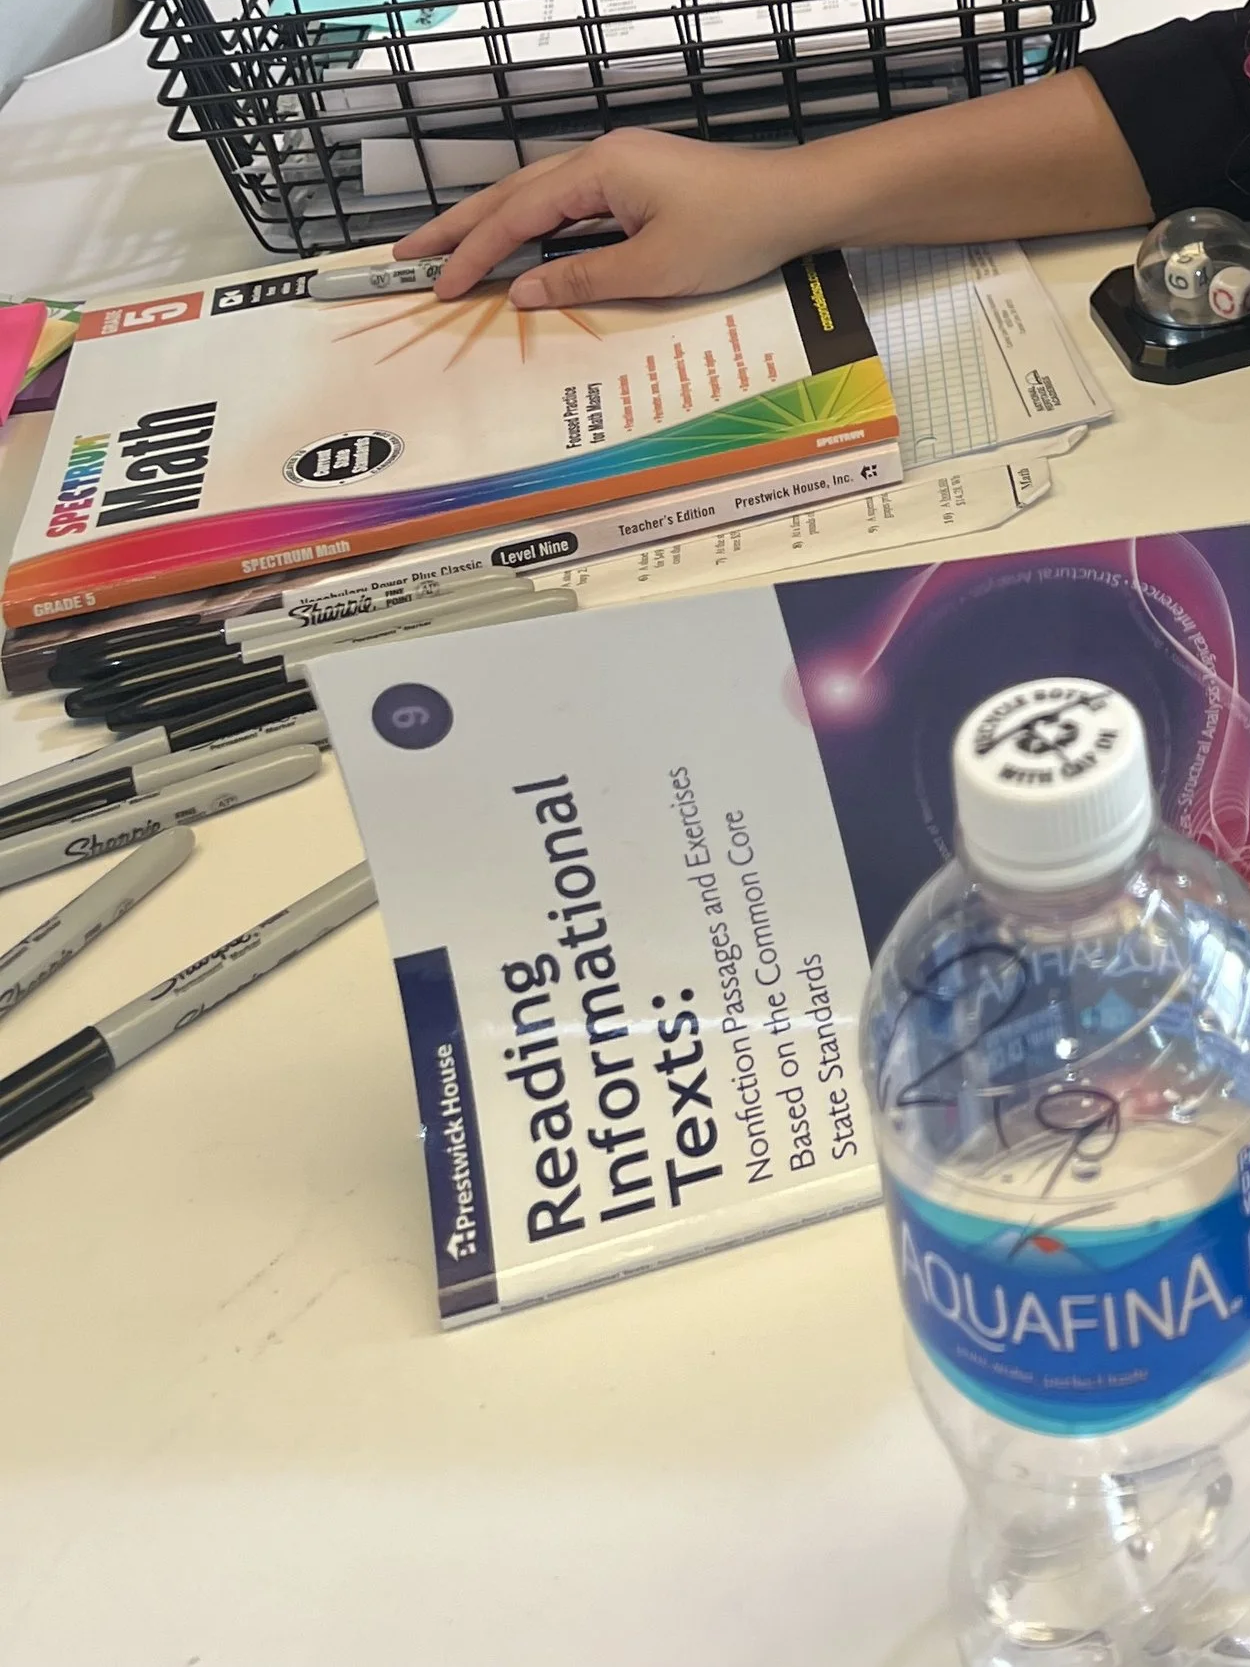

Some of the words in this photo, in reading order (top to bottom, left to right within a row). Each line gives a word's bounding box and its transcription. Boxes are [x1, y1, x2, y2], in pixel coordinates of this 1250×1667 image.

[123, 301, 188, 329] 5
[562, 386, 579, 418] Practice
[564, 418, 582, 450] Focused
[588, 411, 604, 432] Math
[590, 431, 605, 444] for
[46, 433, 111, 538] SPECTRUM
[96, 401, 218, 528] Math
[241, 547, 313, 574] SPECTRUM
[316, 540, 351, 560] Math
[500, 541, 537, 566] Level
[538, 538, 570, 560] Nine
[617, 515, 674, 537] Teacher's
[676, 504, 716, 526] Edition
[735, 487, 791, 510] Prestwick
[792, 479, 831, 498] House,
[832, 473, 855, 488] Inc.
[33, 595, 83, 618] GRADE
[84, 591, 96, 606] 5
[1037, 566, 1122, 588] Structural
[669, 766, 711, 869] Exercises
[725, 809, 755, 866] Core
[688, 873, 724, 915] and
[741, 871, 781, 986] Common
[512, 773, 657, 1224] Informational
[711, 922, 748, 1034] Passages
[764, 992, 791, 1036] the
[797, 953, 844, 1083] Standards
[439, 1042, 463, 1117] House
[501, 950, 587, 1244] Reading
[652, 987, 724, 1207] Texts:
[777, 1040, 800, 1077] on
[732, 1034, 774, 1184] Nonfiction
[776, 1086, 816, 1171] Based
[827, 1087, 858, 1161] State
[444, 1118, 478, 1231] Prestwick
[902, 1220, 1231, 1354] AQUAFINA
